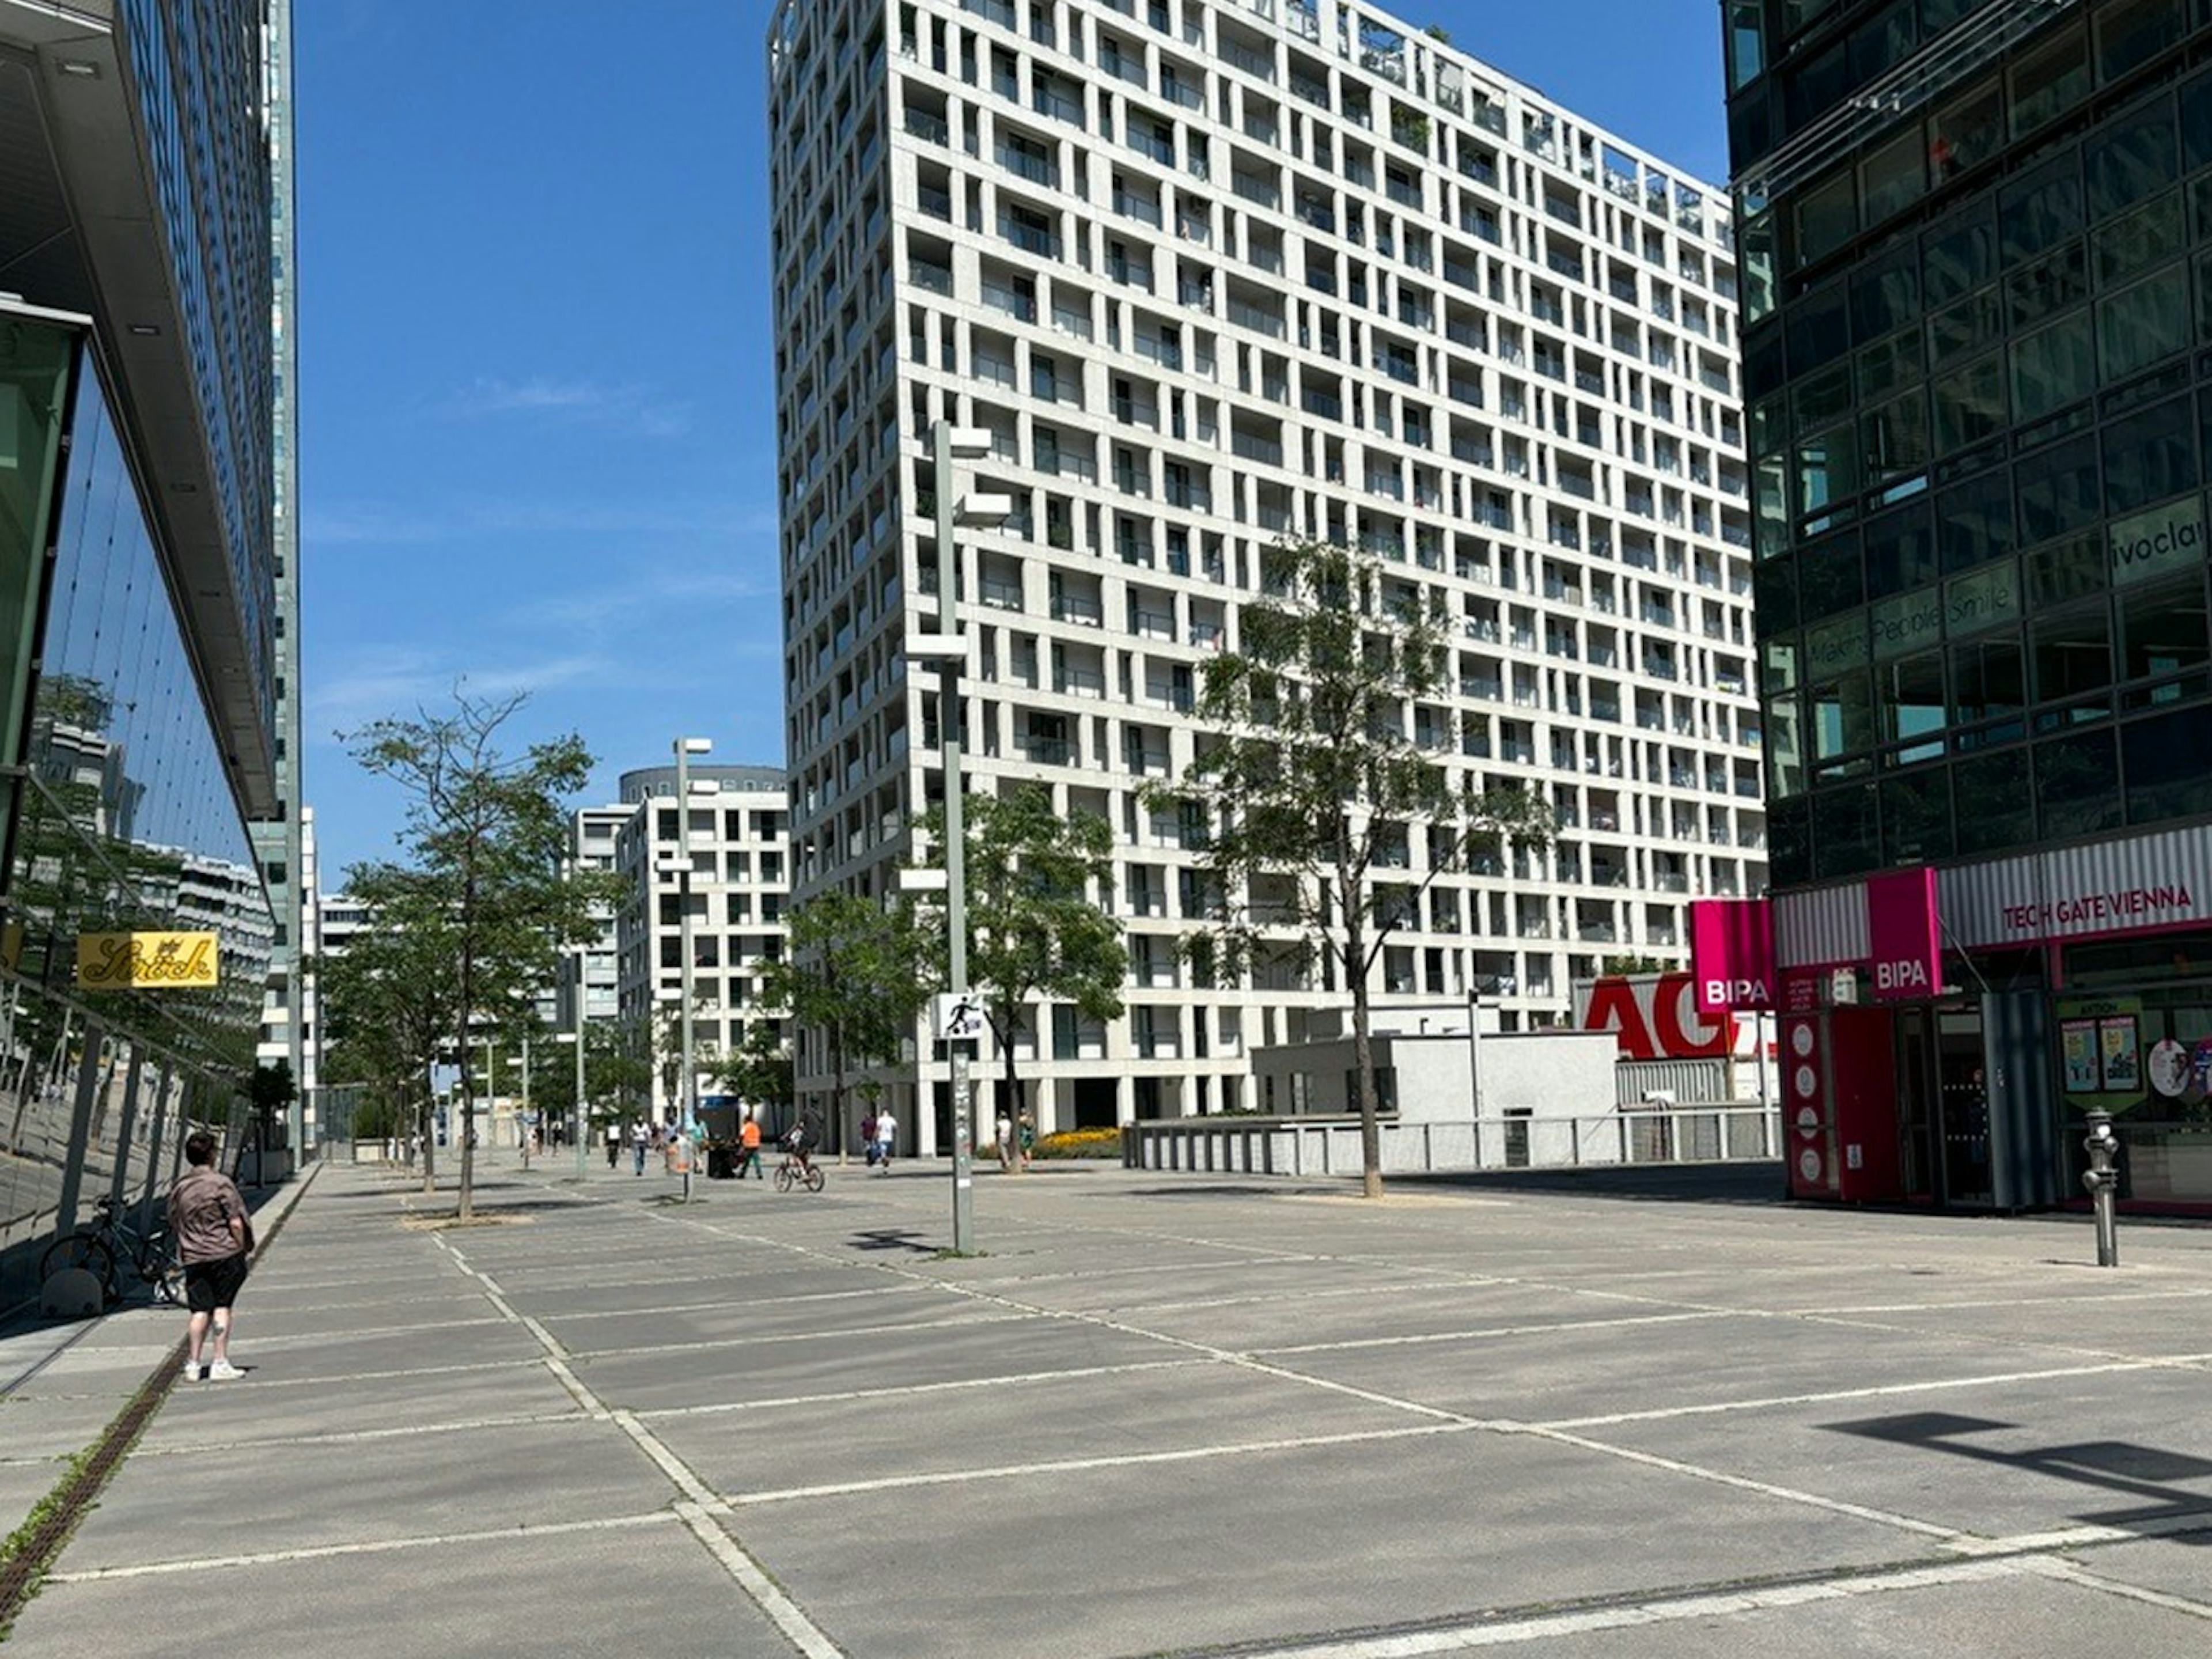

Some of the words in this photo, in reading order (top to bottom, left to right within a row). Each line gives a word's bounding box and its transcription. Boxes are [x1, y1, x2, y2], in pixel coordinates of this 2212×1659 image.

[2003, 903, 2052, 929] TECH
[2056, 896, 2106, 924] GATE
[2108, 884, 2191, 916] VIENNA
[1876, 959, 1927, 990] BIPA
[1705, 979, 1770, 1005] BIPA
